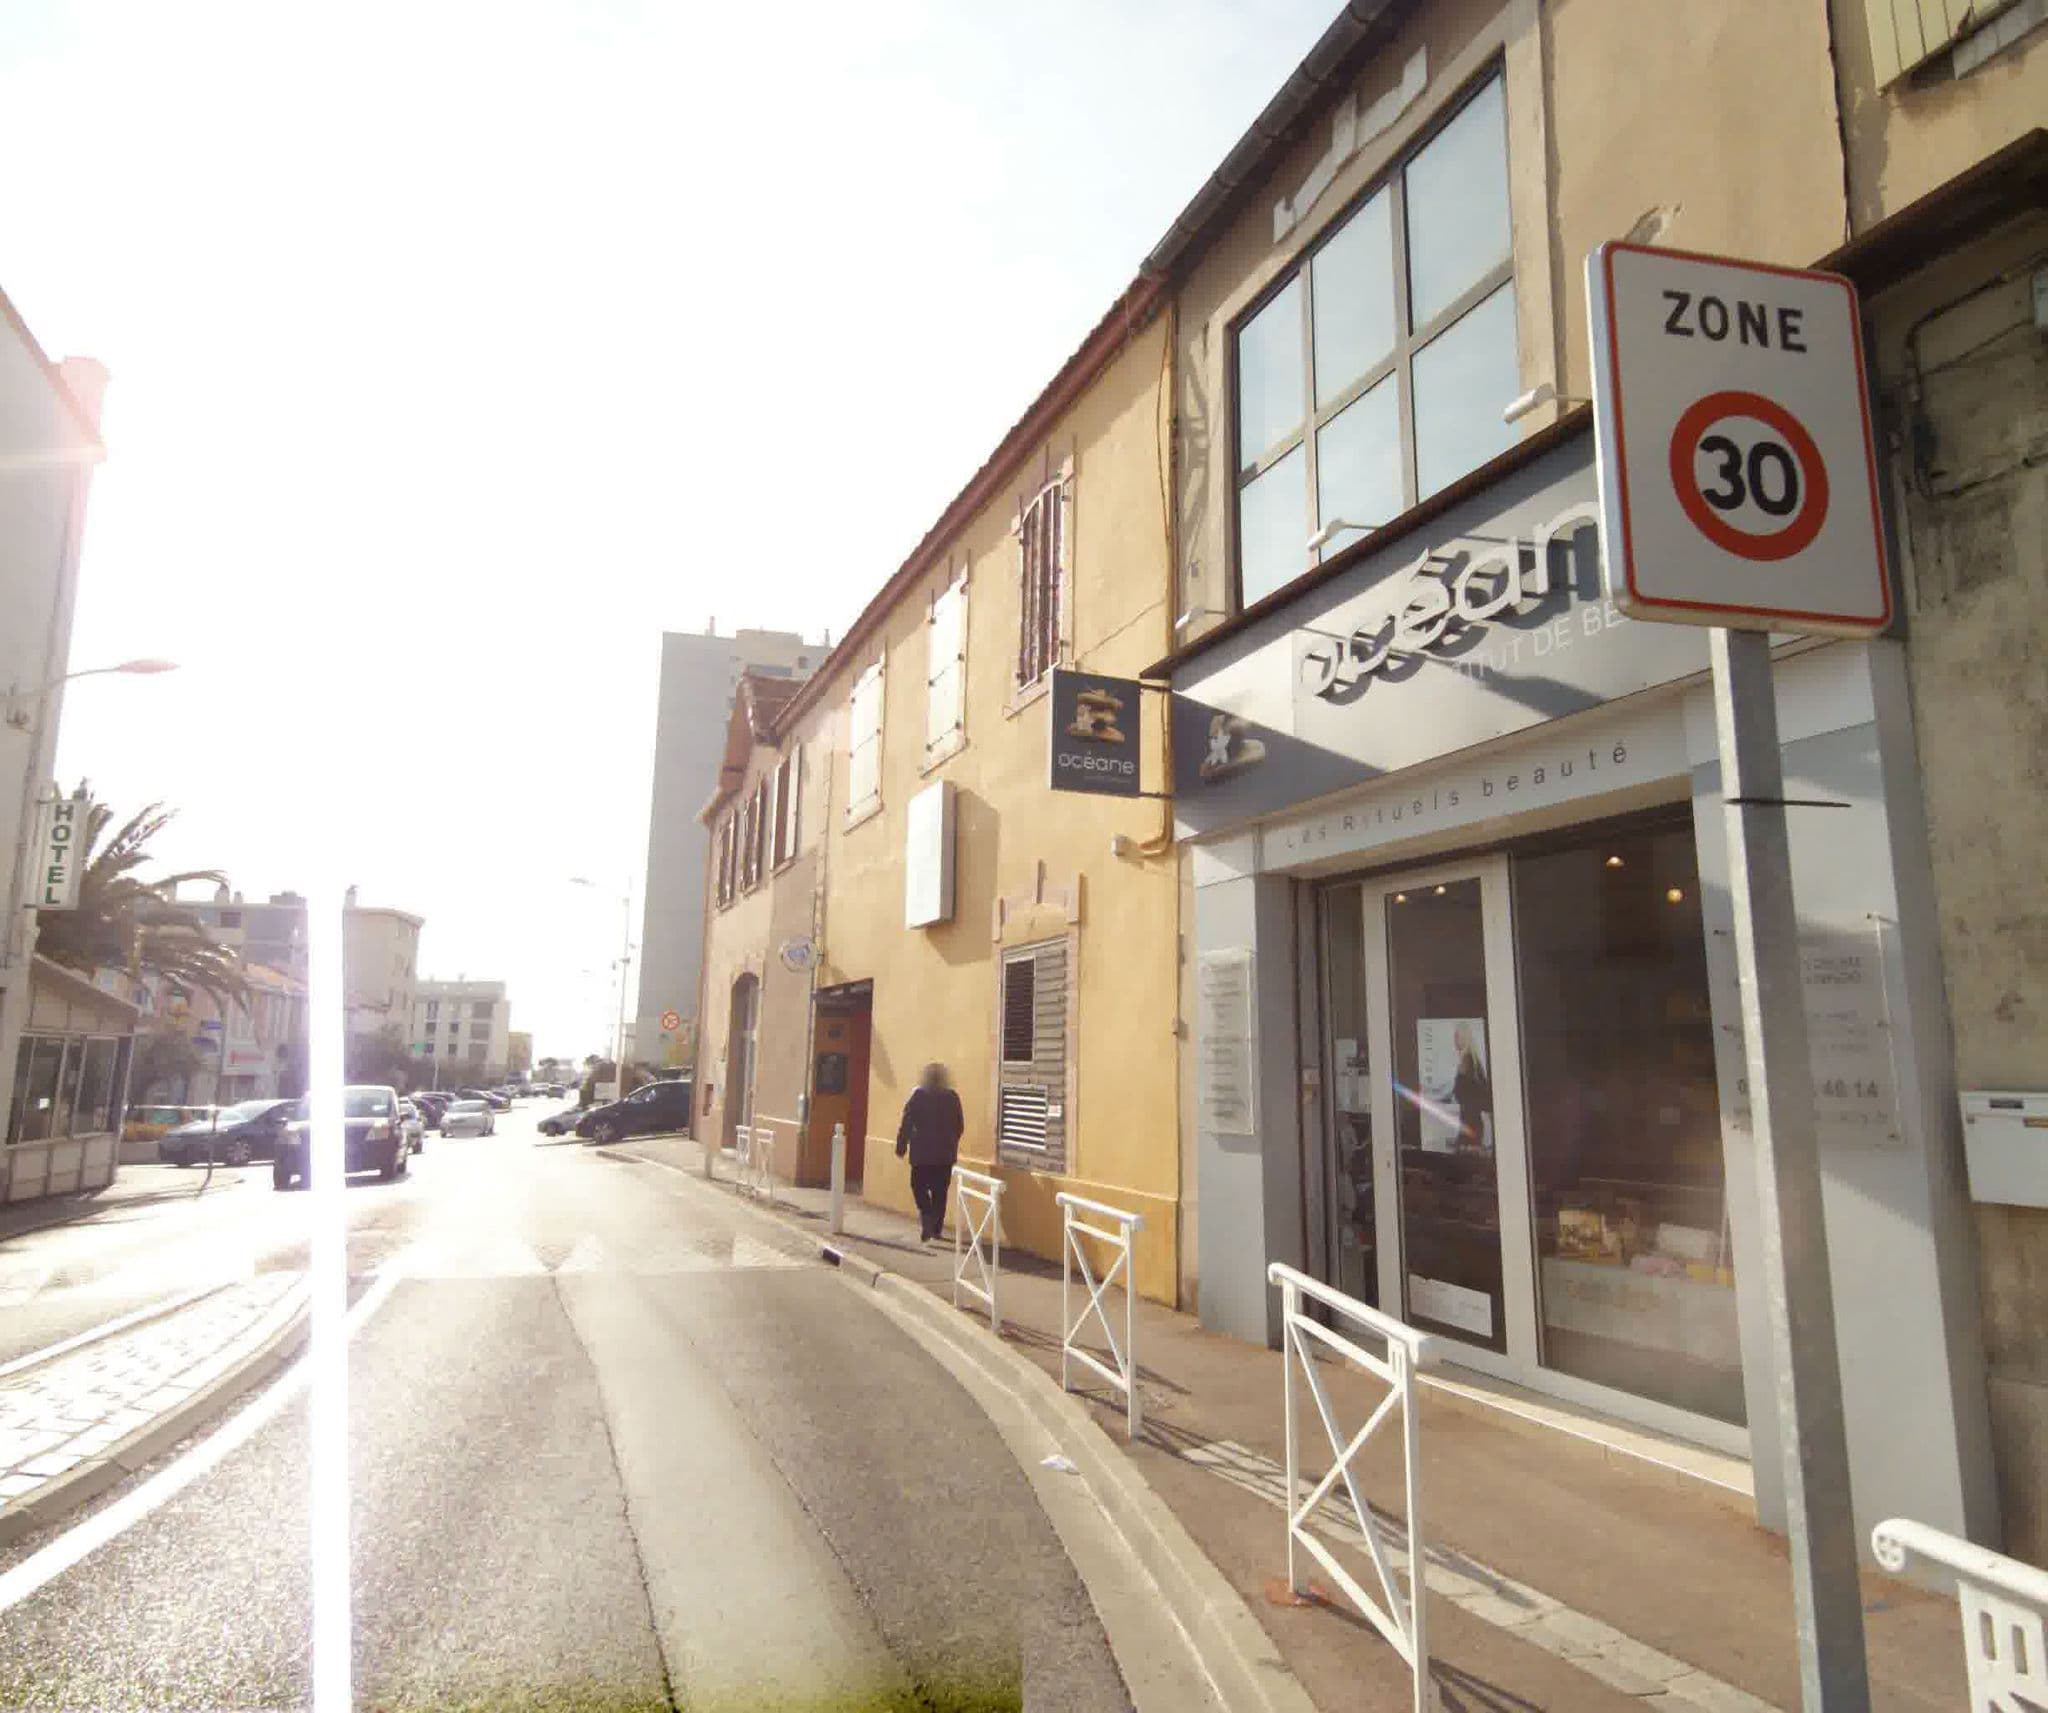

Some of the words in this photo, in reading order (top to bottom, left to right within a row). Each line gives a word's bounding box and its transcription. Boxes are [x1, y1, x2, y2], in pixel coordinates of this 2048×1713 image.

[1662, 289, 1808, 354] ZONE
[1699, 435, 1799, 516] 30
[1532, 616, 1573, 658] DE
[1057, 749, 1135, 775] océane
[1342, 787, 1460, 832] Rituels
[1482, 740, 1628, 798] beauté
[44, 804, 75, 905] HOTEL
